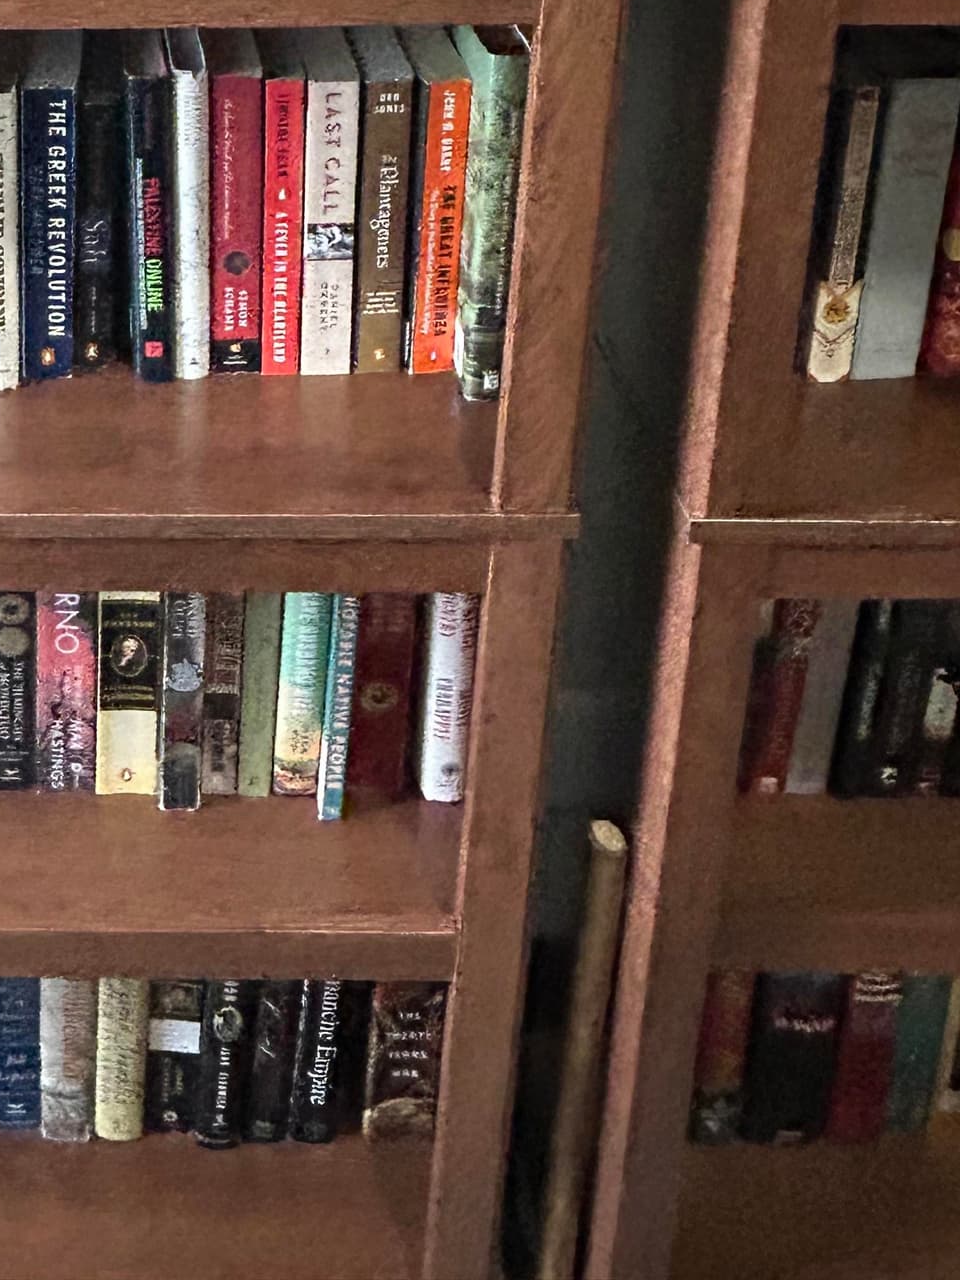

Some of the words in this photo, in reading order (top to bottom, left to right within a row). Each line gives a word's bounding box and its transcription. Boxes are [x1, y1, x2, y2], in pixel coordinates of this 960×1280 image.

[47, 99, 67, 137] THE
[324, 91, 342, 148] LAST
[47, 146, 67, 209] GREEK
[323, 157, 341, 215] CALL
[441, 185, 457, 211] THE
[273, 222, 288, 258] FEVER
[368, 165, 399, 269] Plantagenets
[438, 216, 456, 259] GREAT
[47, 218, 67, 337] REVOLUTION
[146, 259, 164, 312] ONLINE
[272, 261, 288, 274] IN
[272, 277, 288, 301] THE
[223, 287, 235, 331] SCHAMA
[236, 290, 249, 327] SIMON
[271, 303, 288, 364] HEARTLAND
[333, 674, 353, 729] NATIVE
[50, 720, 66, 789] HASTINGS
[307, 1046, 338, 1106] Empire
